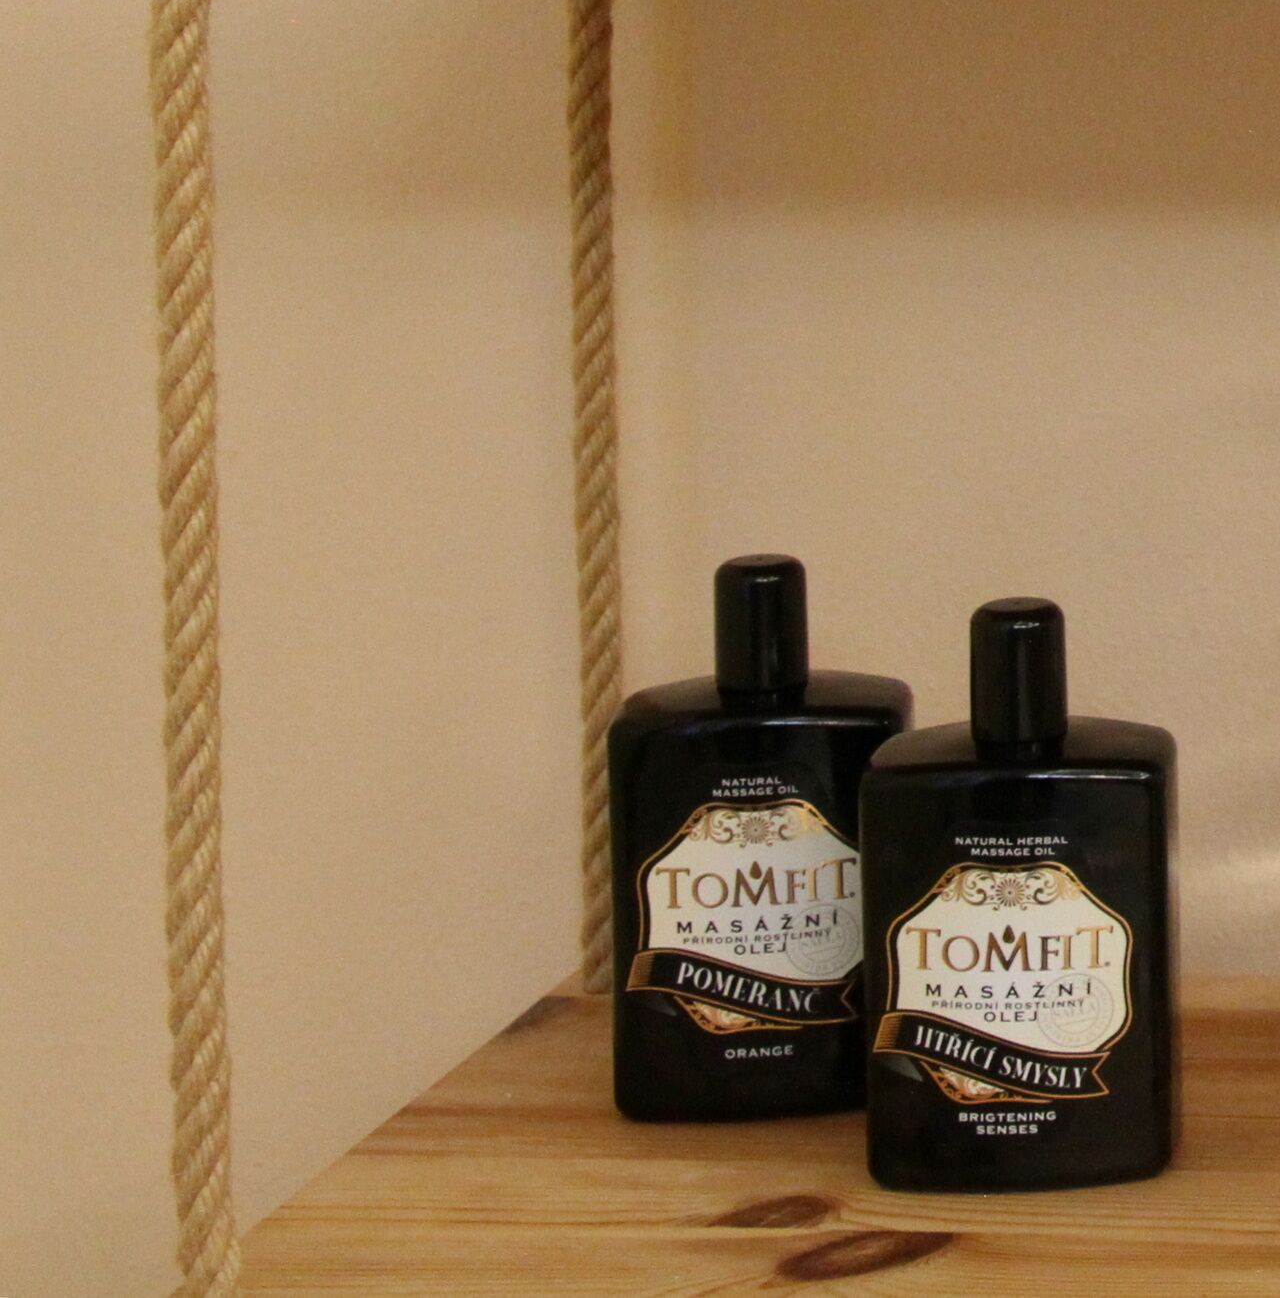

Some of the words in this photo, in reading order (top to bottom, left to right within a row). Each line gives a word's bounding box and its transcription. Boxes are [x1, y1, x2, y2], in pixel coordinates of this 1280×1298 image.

[721, 776, 783, 788] NATURAL
[712, 786, 773, 798] MASSAGE
[778, 785, 799, 795] OIL
[955, 836, 1014, 846] NATURAL
[1016, 835, 1068, 845] HERBAL
[970, 846, 1031, 857] MASSAGE
[1034, 846, 1055, 856] OIL
[676, 912, 839, 935] MASÁŽNÍ
[682, 932, 748, 945] PŘÍRODNÍ
[754, 926, 832, 943] ROSTLINNÝ
[734, 940, 787, 955] OLEJ
[676, 961, 823, 1015] POMERANČ
[925, 981, 1092, 999] MASÁŽNÍ
[931, 999, 999, 1011] PŘÍRODNÍ
[1004, 998, 1085, 1011] ROSTLINNÝ
[983, 1010, 1039, 1023] OLEJ
[724, 1044, 794, 1060] ORANGE
[913, 1025, 997, 1071] JITŘÍCÍ
[999, 1052, 1087, 1089] SMYSLY
[958, 1110, 1057, 1123] BRIGTENING
[976, 1123, 1039, 1136] SENSES
